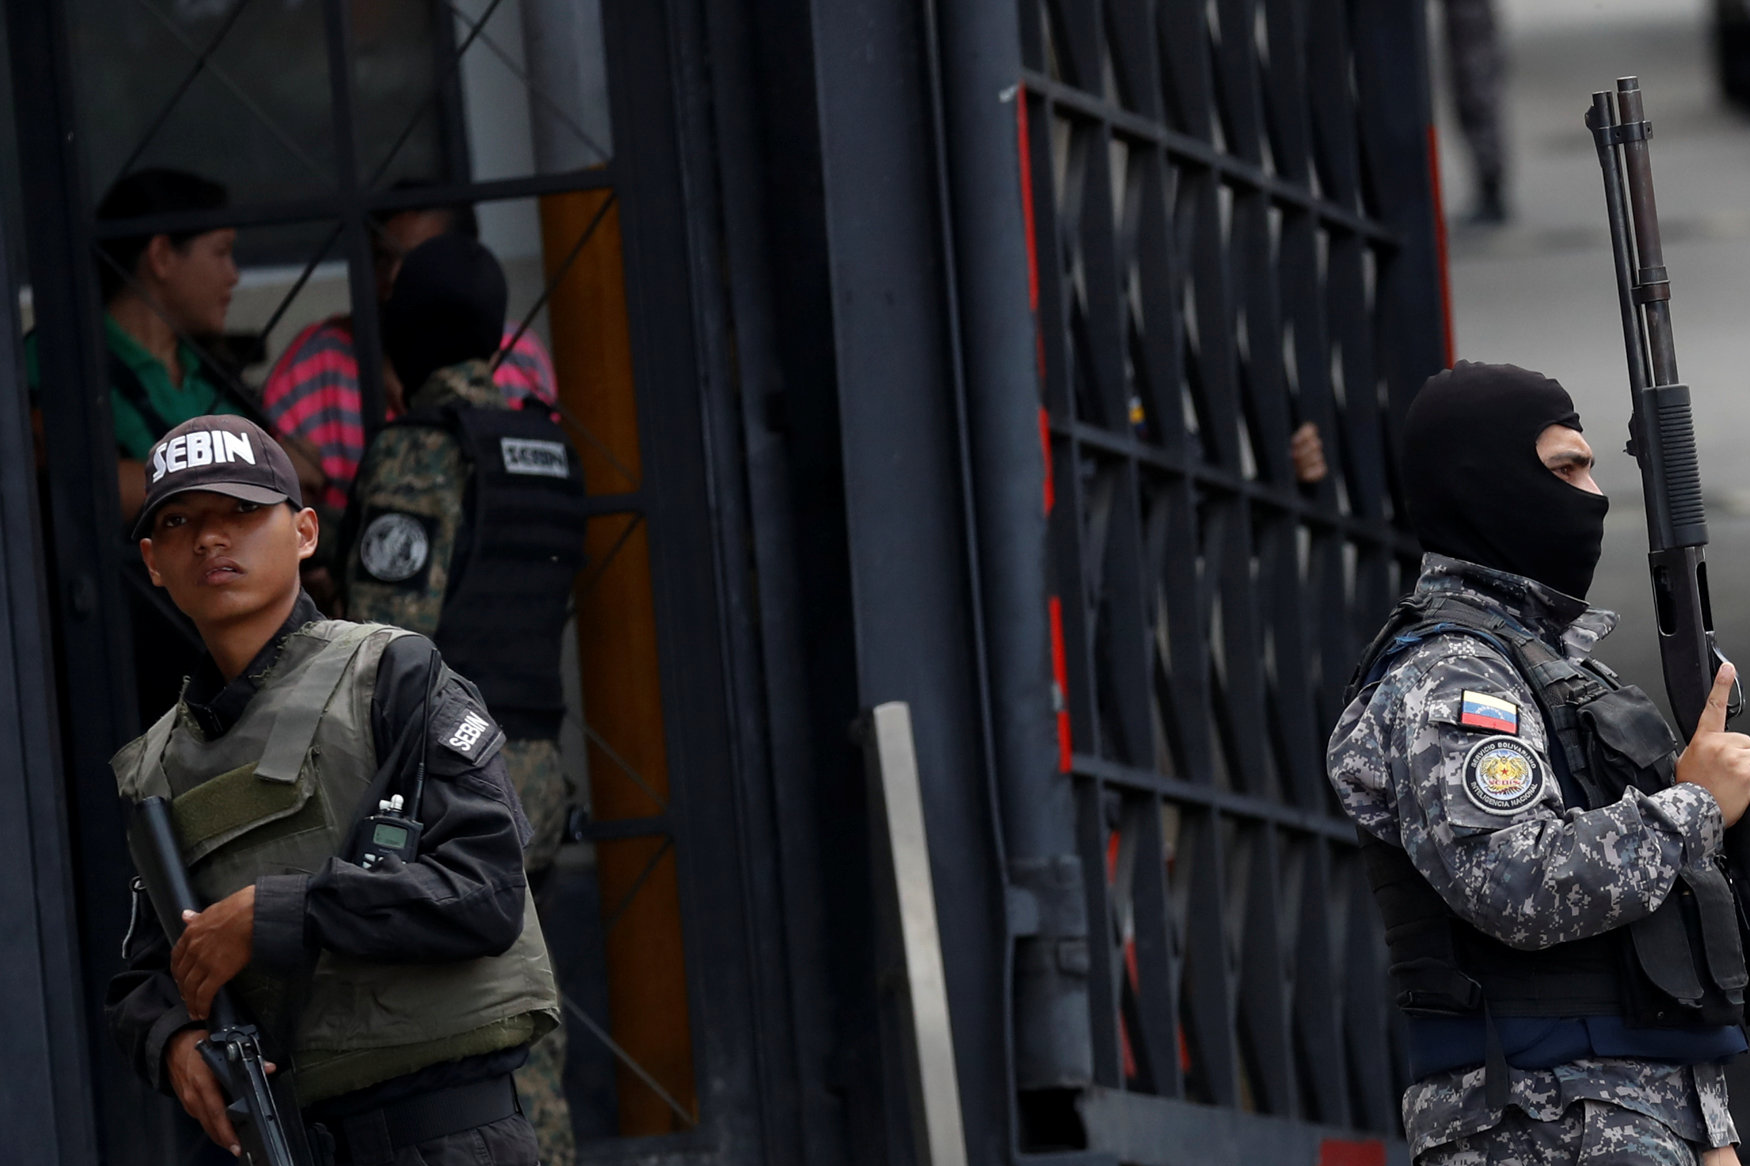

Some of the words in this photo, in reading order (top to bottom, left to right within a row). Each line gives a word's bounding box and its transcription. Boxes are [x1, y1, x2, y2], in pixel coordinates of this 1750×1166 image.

[153, 430, 256, 484] SEBIN
[449, 711, 490, 752] SEBIN
[1471, 743, 1496, 768] SERVICIO
[1497, 742, 1537, 769] BOLIVARIANO
[1470, 781, 1510, 808] INTELIGENCIA
[1511, 783, 1538, 807] NACIONAL
